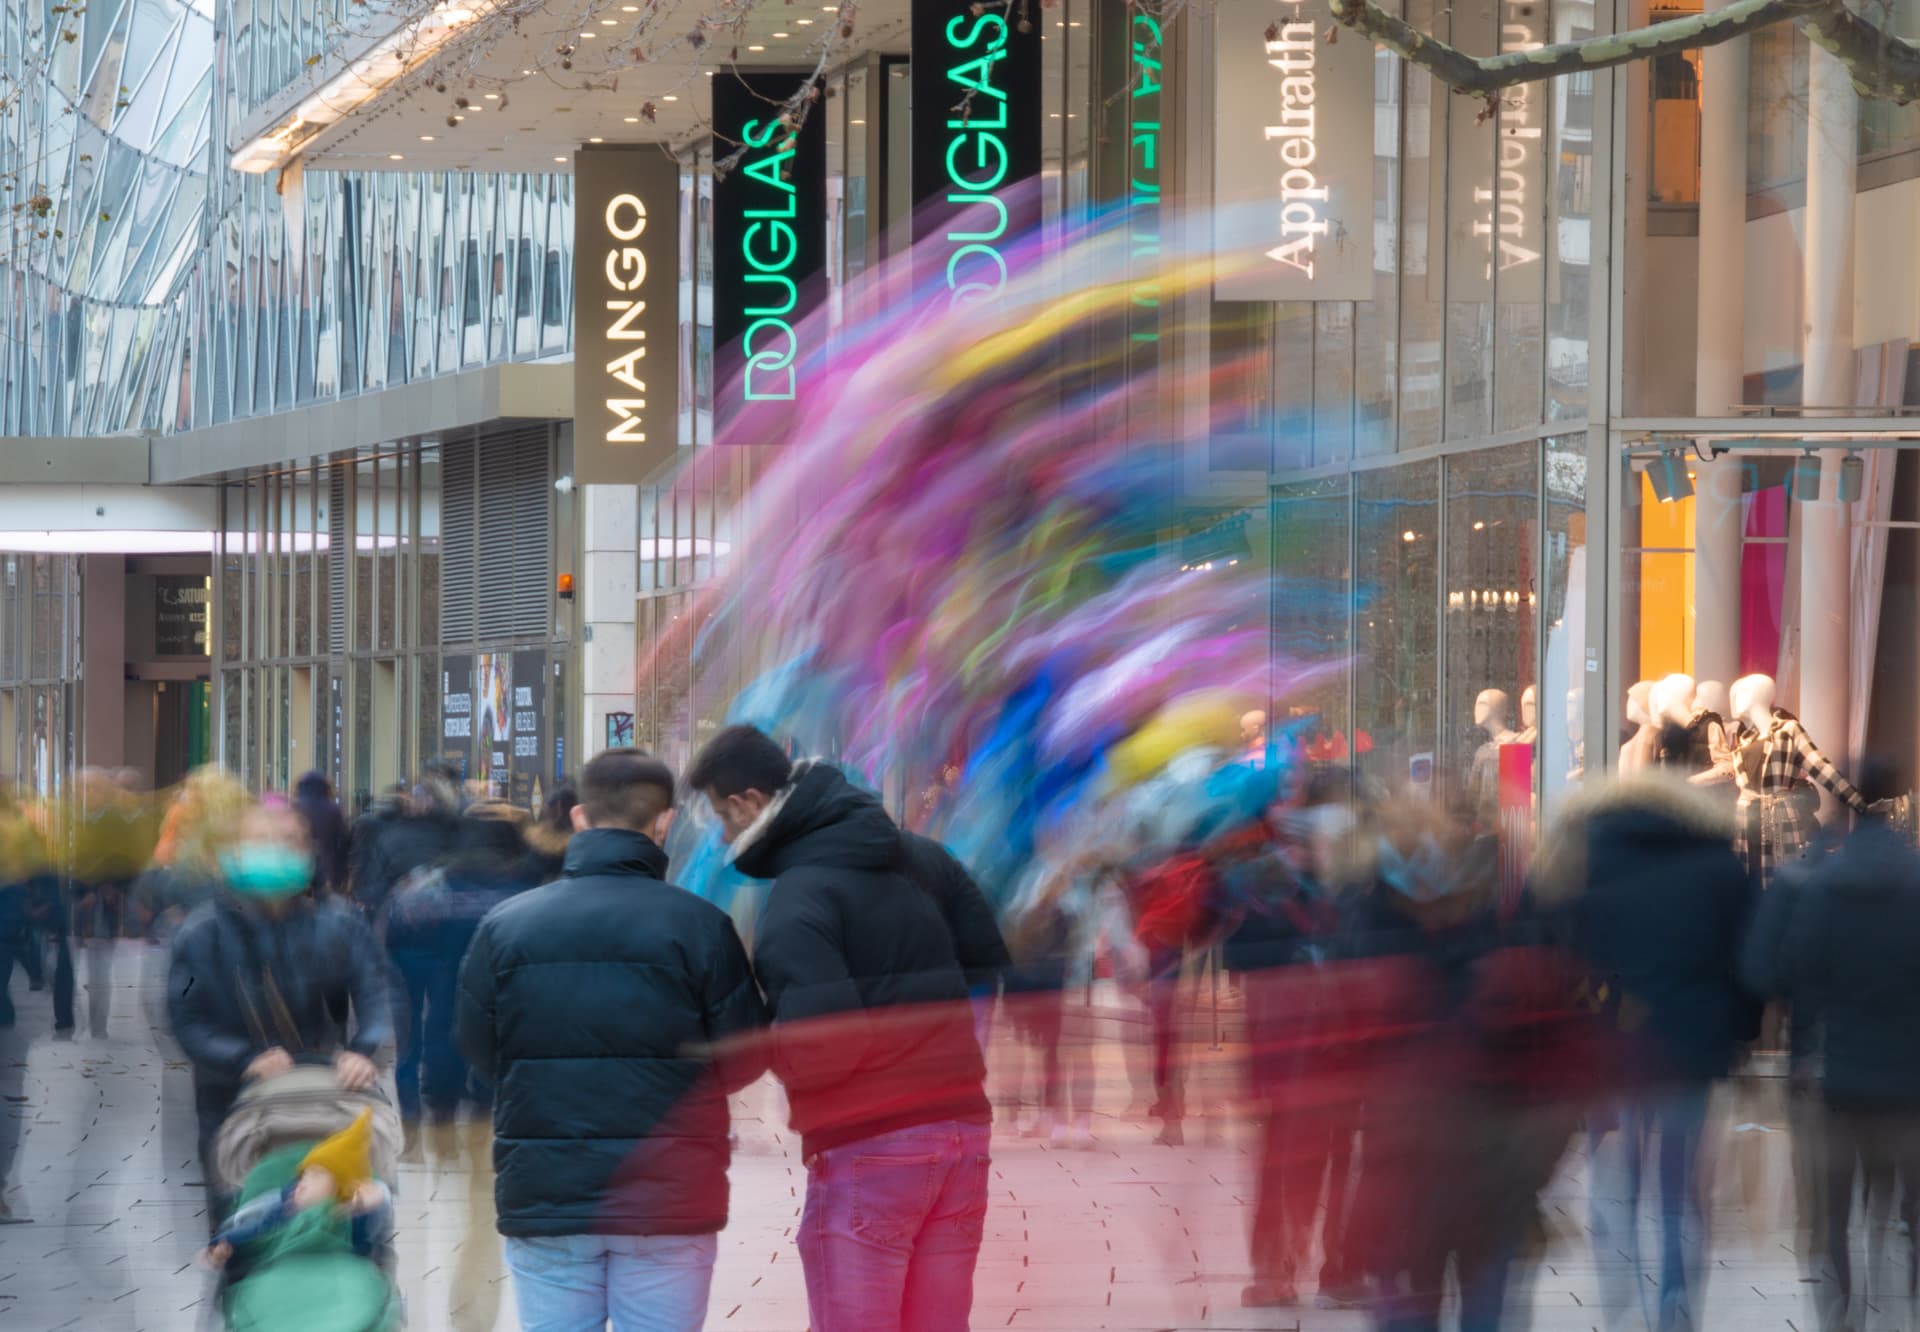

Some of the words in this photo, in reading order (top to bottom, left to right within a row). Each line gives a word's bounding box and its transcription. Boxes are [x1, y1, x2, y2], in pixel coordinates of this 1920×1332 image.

[742, 117, 799, 401] DOUGLAS
[1265, 0, 1330, 281] Appelrath-
[605, 192, 648, 443] MANGO
[178, 588, 211, 604] SATUR
